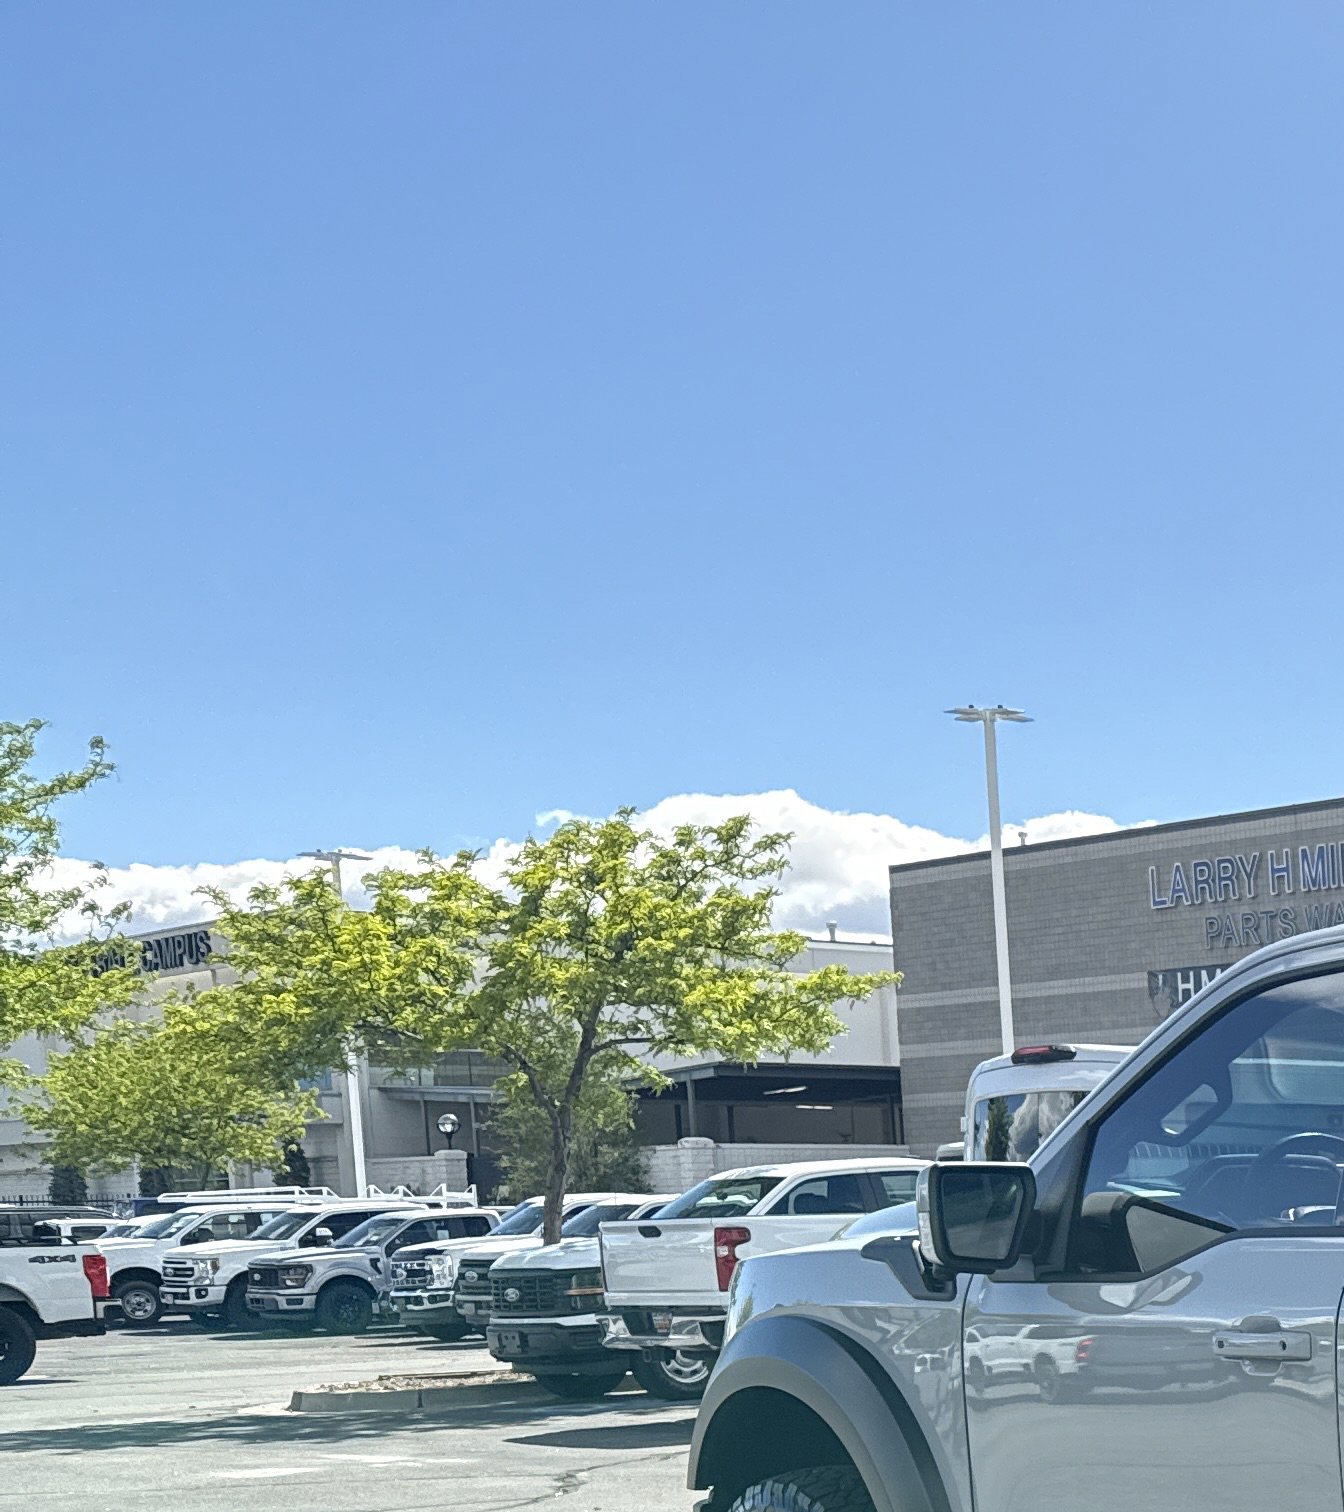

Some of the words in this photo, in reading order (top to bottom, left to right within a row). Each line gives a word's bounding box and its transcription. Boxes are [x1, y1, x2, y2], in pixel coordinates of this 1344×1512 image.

[1148, 851, 1259, 910] LARRY
[1268, 847, 1294, 896] H
[1204, 906, 1297, 950] PARTS
[141, 930, 213, 972] CAMPUS
